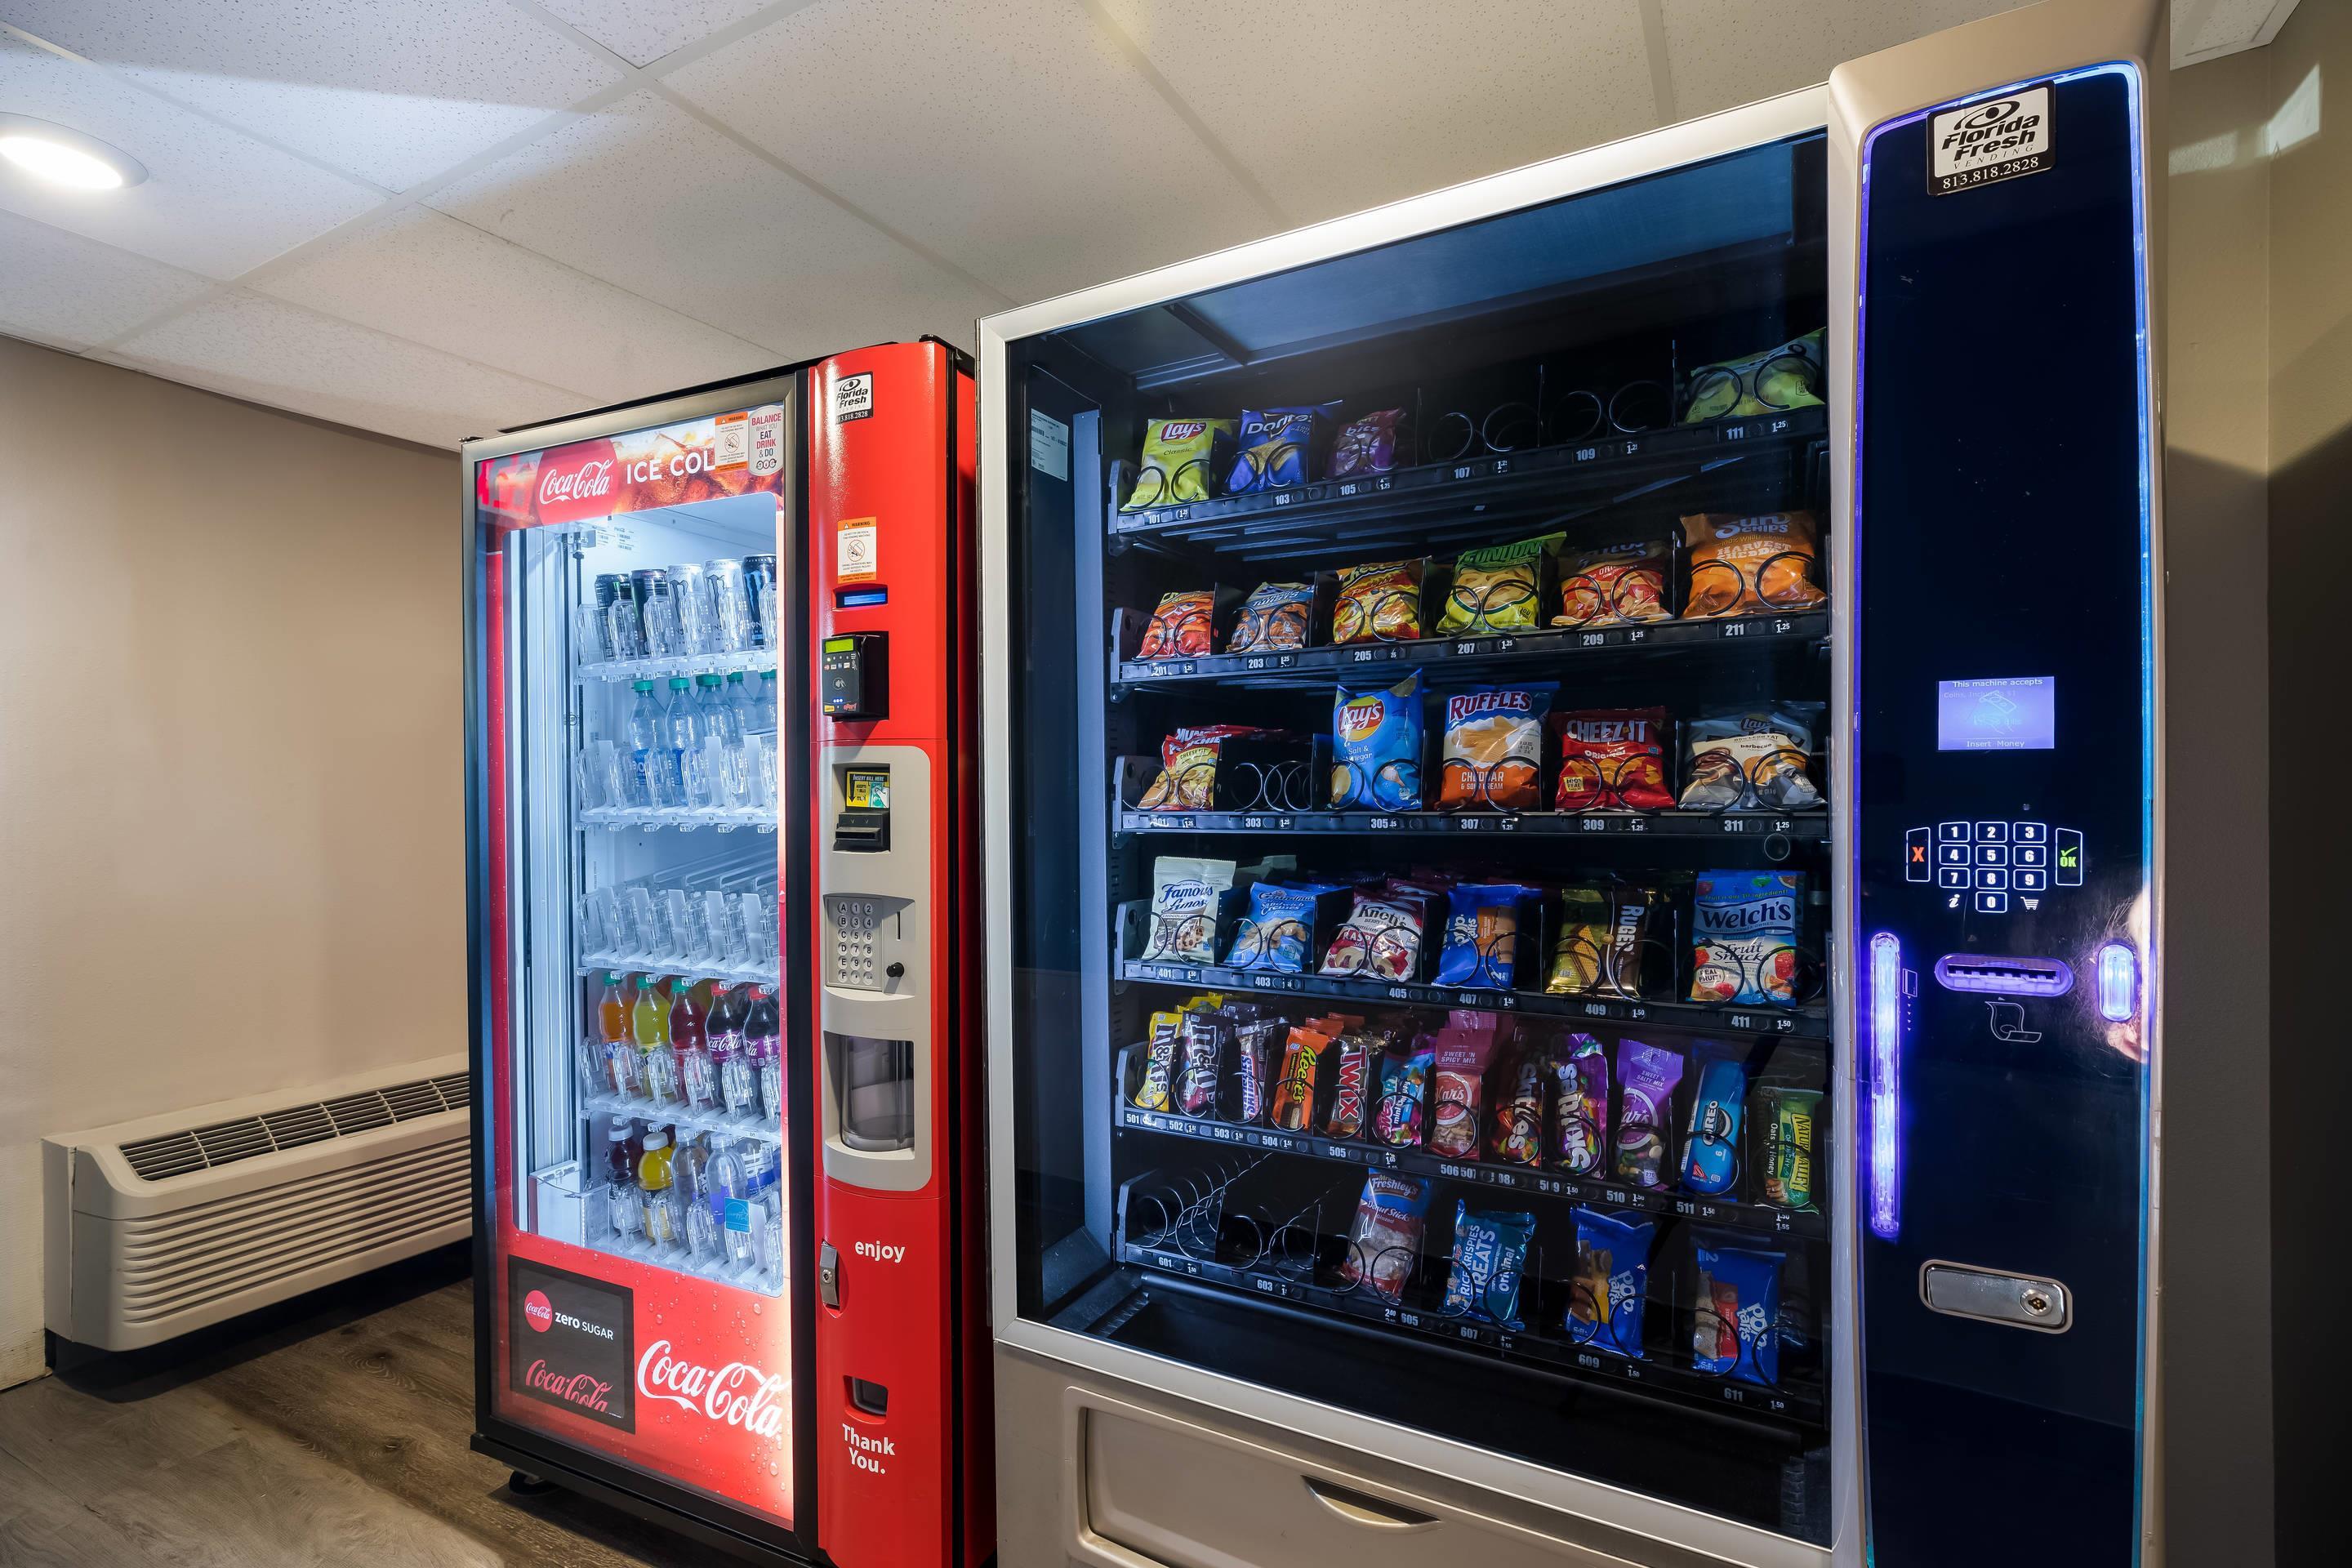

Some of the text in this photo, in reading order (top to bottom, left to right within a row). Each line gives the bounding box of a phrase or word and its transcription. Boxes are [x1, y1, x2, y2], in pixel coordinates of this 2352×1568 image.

[1941, 114, 2040, 150] Florida
[1953, 129, 2036, 162] Fresh
[1953, 144, 2034, 170] VENDING
[1943, 156, 2039, 189] 813.818.2828
[836, 388, 868, 402] Florida
[840, 396, 866, 408] Fresh
[751, 413, 782, 426] BALANCE
[760, 430, 773, 439] EAT
[1726, 426, 1744, 440] 111
[756, 439, 777, 449] DRINK
[759, 448, 773, 458] & DO
[1575, 448, 1596, 461] 109
[539, 449, 716, 505] Coca-Cola ICE COL
[1454, 466, 1470, 479] 107
[1340, 483, 1356, 496] 105
[1275, 493, 1290, 506] 103
[1148, 514, 1160, 525] 101
[1740, 524, 1788, 533] CHIPS
[1725, 624, 1744, 636] 211
[1583, 633, 1605, 645] 209
[1458, 643, 1475, 654] 207
[1354, 651, 1372, 662] 205
[1248, 658, 1264, 669] 203
[2010, 679, 2042, 687] accepts
[1449, 692, 1533, 724] RUFFLES
[1567, 720, 1648, 743] CHEEZ-IT
[1997, 740, 2025, 749] Money
[1348, 746, 1361, 755] Salt
[1245, 818, 1262, 828] 303
[1370, 818, 1388, 829] 305
[1461, 819, 1478, 830] 307
[1583, 819, 1605, 830] 309
[1724, 820, 1744, 831] 311
[1951, 826, 1958, 838] 1
[1987, 826, 1995, 838] 2
[2025, 826, 2034, 838] 3
[1950, 849, 1958, 860] 4
[1987, 849, 1995, 861] 5
[2025, 850, 2034, 862] 6
[2060, 856, 2077, 867] OK
[1950, 872, 1958, 884] 7
[1987, 873, 1995, 884] 8
[2025, 874, 2034, 885] 9
[1159, 884, 1213, 903] Famous
[1987, 896, 1995, 908] 0
[841, 904, 846, 912] A
[866, 905, 871, 913] 2
[841, 917, 846, 925] B
[1700, 902, 1792, 929] Welch's
[854, 918, 858, 926] 3
[866, 919, 871, 927] 4
[841, 931, 846, 939] C
[854, 932, 858, 940] 5
[866, 933, 871, 941] 6
[841, 944, 846, 952] D
[854, 946, 858, 954] 7
[866, 947, 871, 955] 8
[1725, 942, 1764, 953] Fruit
[841, 958, 846, 966] E
[854, 959, 858, 967] 9
[867, 960, 871, 968] 0
[1159, 969, 1172, 978] 401
[1255, 977, 1271, 987] 403
[1389, 989, 1407, 999] 405
[1459, 993, 1477, 1004] 407
[1585, 1004, 1606, 1016] 409
[1731, 1015, 1750, 1028] 411
[1441, 1056, 1461, 1064] SPICY
[1642, 1070, 1659, 1080] SWEET
[1637, 1075, 1664, 1087] SALTY MIX
[1127, 1114, 1139, 1125] 501
[1703, 1100, 1718, 1146] OREO
[1169, 1122, 1183, 1132] 502
[1215, 1128, 1229, 1138] 503
[1263, 1136, 1278, 1147] 504
[1329, 1146, 1347, 1158] 505
[1767, 1123, 1779, 1176] Oats Honey
[1441, 1164, 1459, 1177] 506
[1370, 1177, 1419, 1196] Freshley's
[1606, 1190, 1625, 1203] 510
[1676, 1201, 1695, 1215] 511
[854, 1240, 906, 1263] enjoy
[1158, 1257, 1173, 1268] 601
[1257, 1280, 1273, 1291] 603
[526, 1302, 614, 1340] Coca-Cola zero SUGAR
[1401, 1312, 1419, 1326] 605
[1460, 1327, 1478, 1340] 607
[1579, 1354, 1600, 1369] 609
[637, 1339, 791, 1439] Coca-Cola
[1724, 1388, 1744, 1403] 611
[842, 1423, 895, 1456] Thank
[848, 1446, 886, 1475] You.
